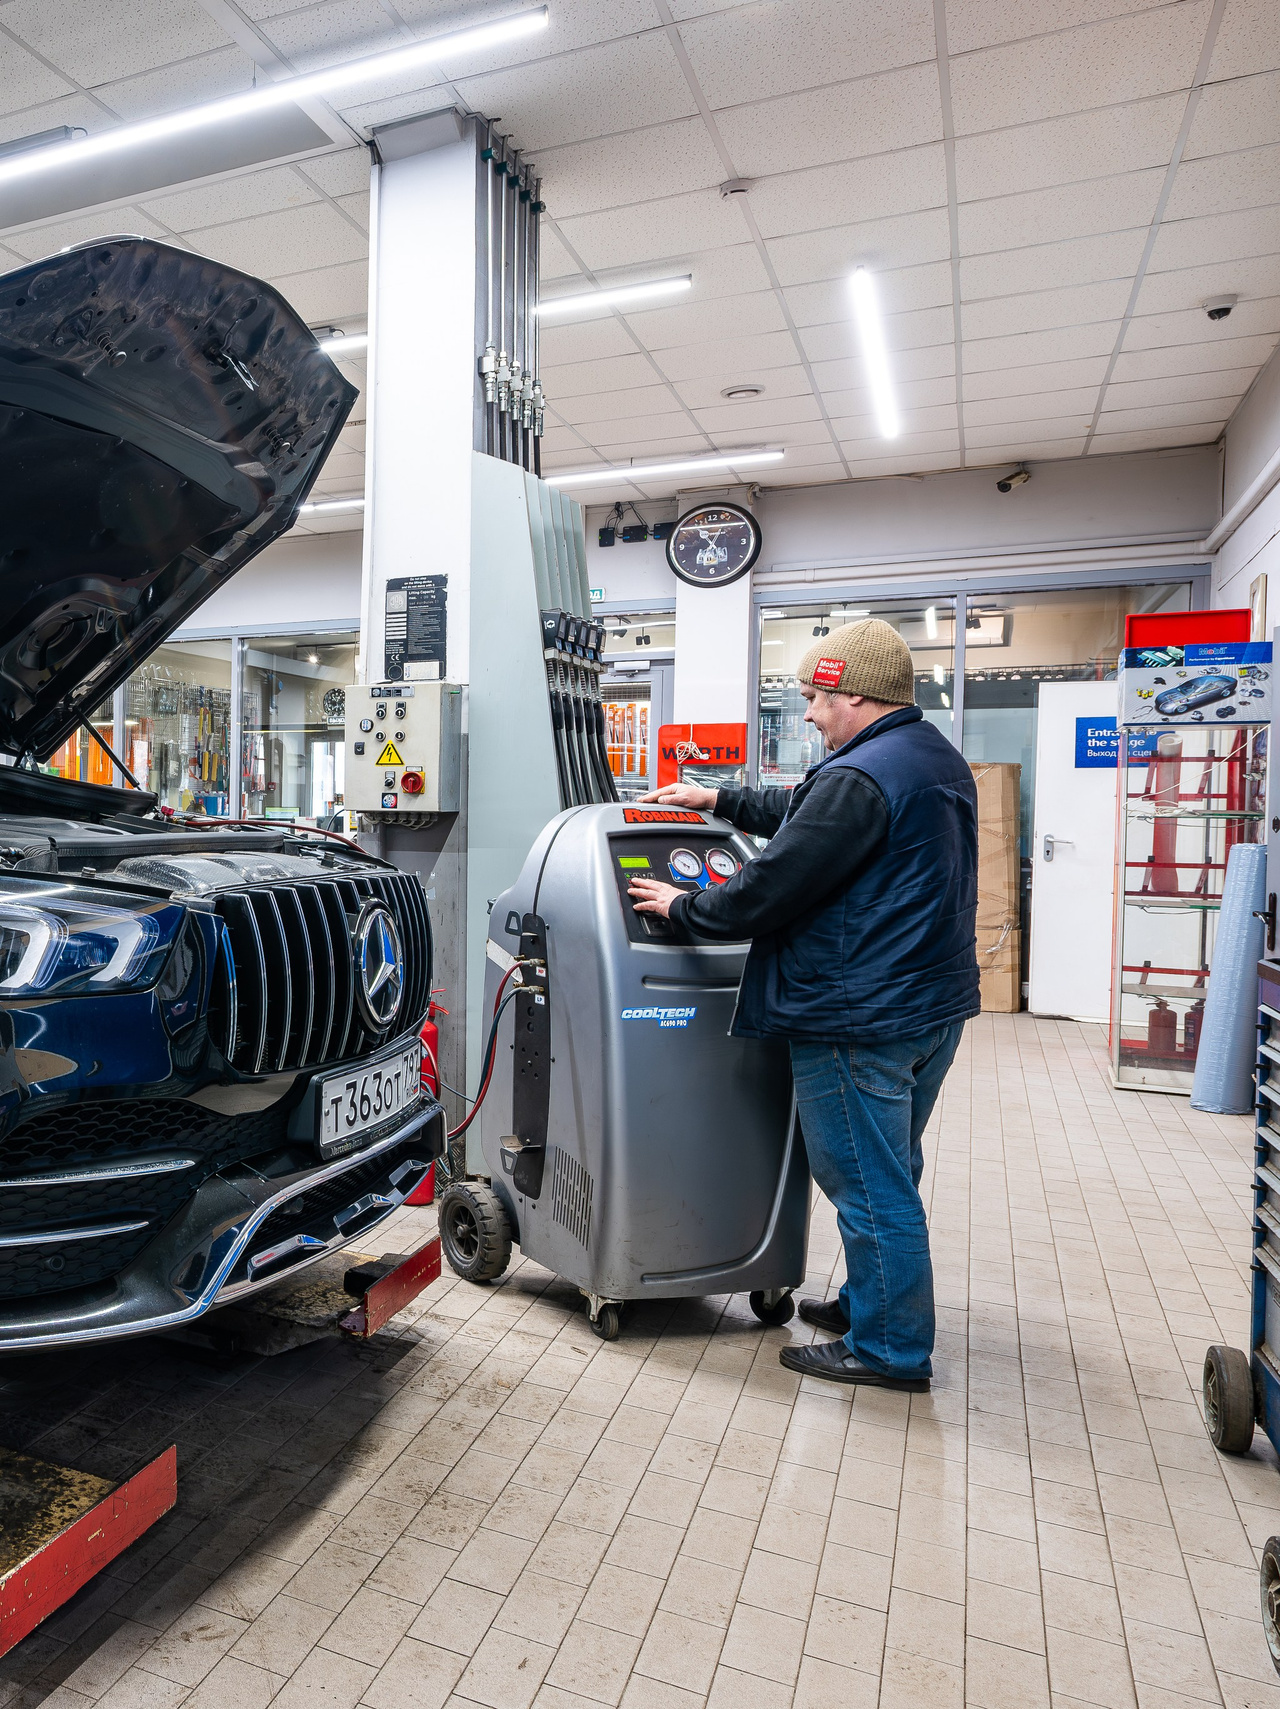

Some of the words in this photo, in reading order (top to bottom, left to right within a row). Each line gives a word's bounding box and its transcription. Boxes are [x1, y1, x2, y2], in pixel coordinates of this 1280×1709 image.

[1198, 647, 1226, 655] Mobil
[819, 660, 839, 668] Mobil
[817, 667, 840, 676] Service
[1087, 738, 1108, 747] the
[1110, 739, 1145, 748] stge
[1087, 749, 1117, 757] Выход
[624, 808, 705, 824] ROBINAIR
[621, 1007, 696, 1019] COOLTECH
